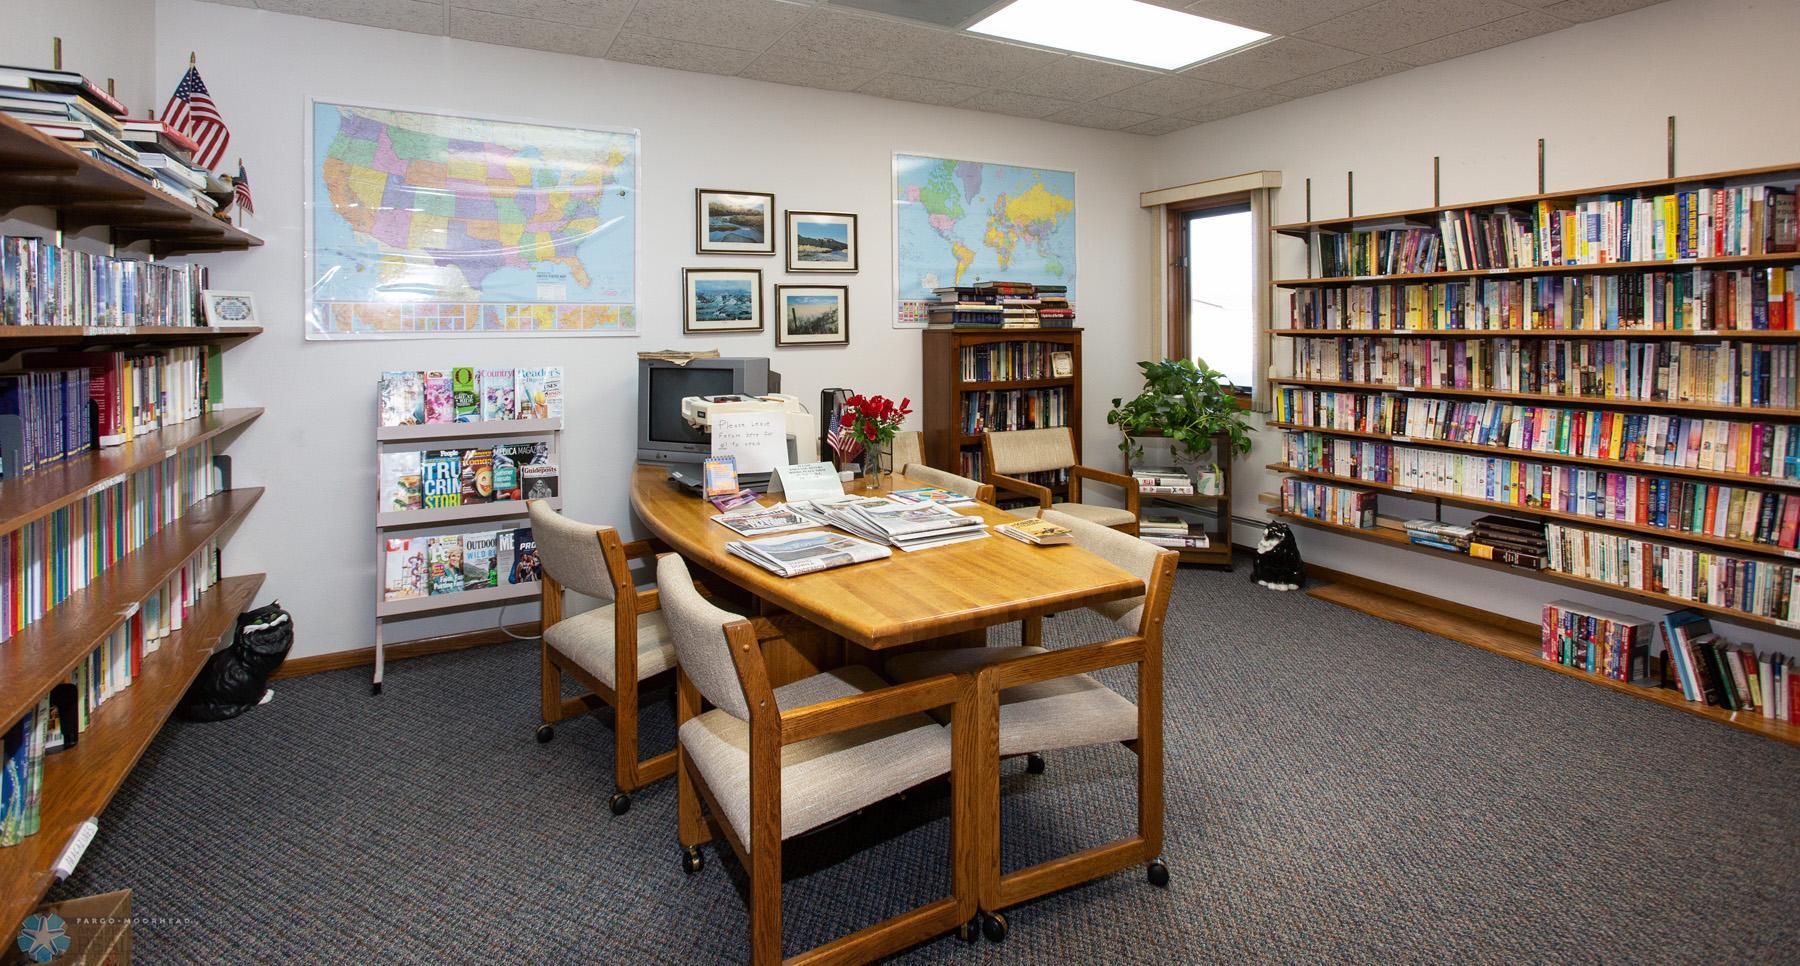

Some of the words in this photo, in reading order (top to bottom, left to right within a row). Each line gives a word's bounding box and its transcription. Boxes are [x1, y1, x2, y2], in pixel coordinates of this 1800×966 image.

[454, 367, 473, 385] O
[480, 369, 512, 379] Country
[524, 466, 557, 475] Guideposts
